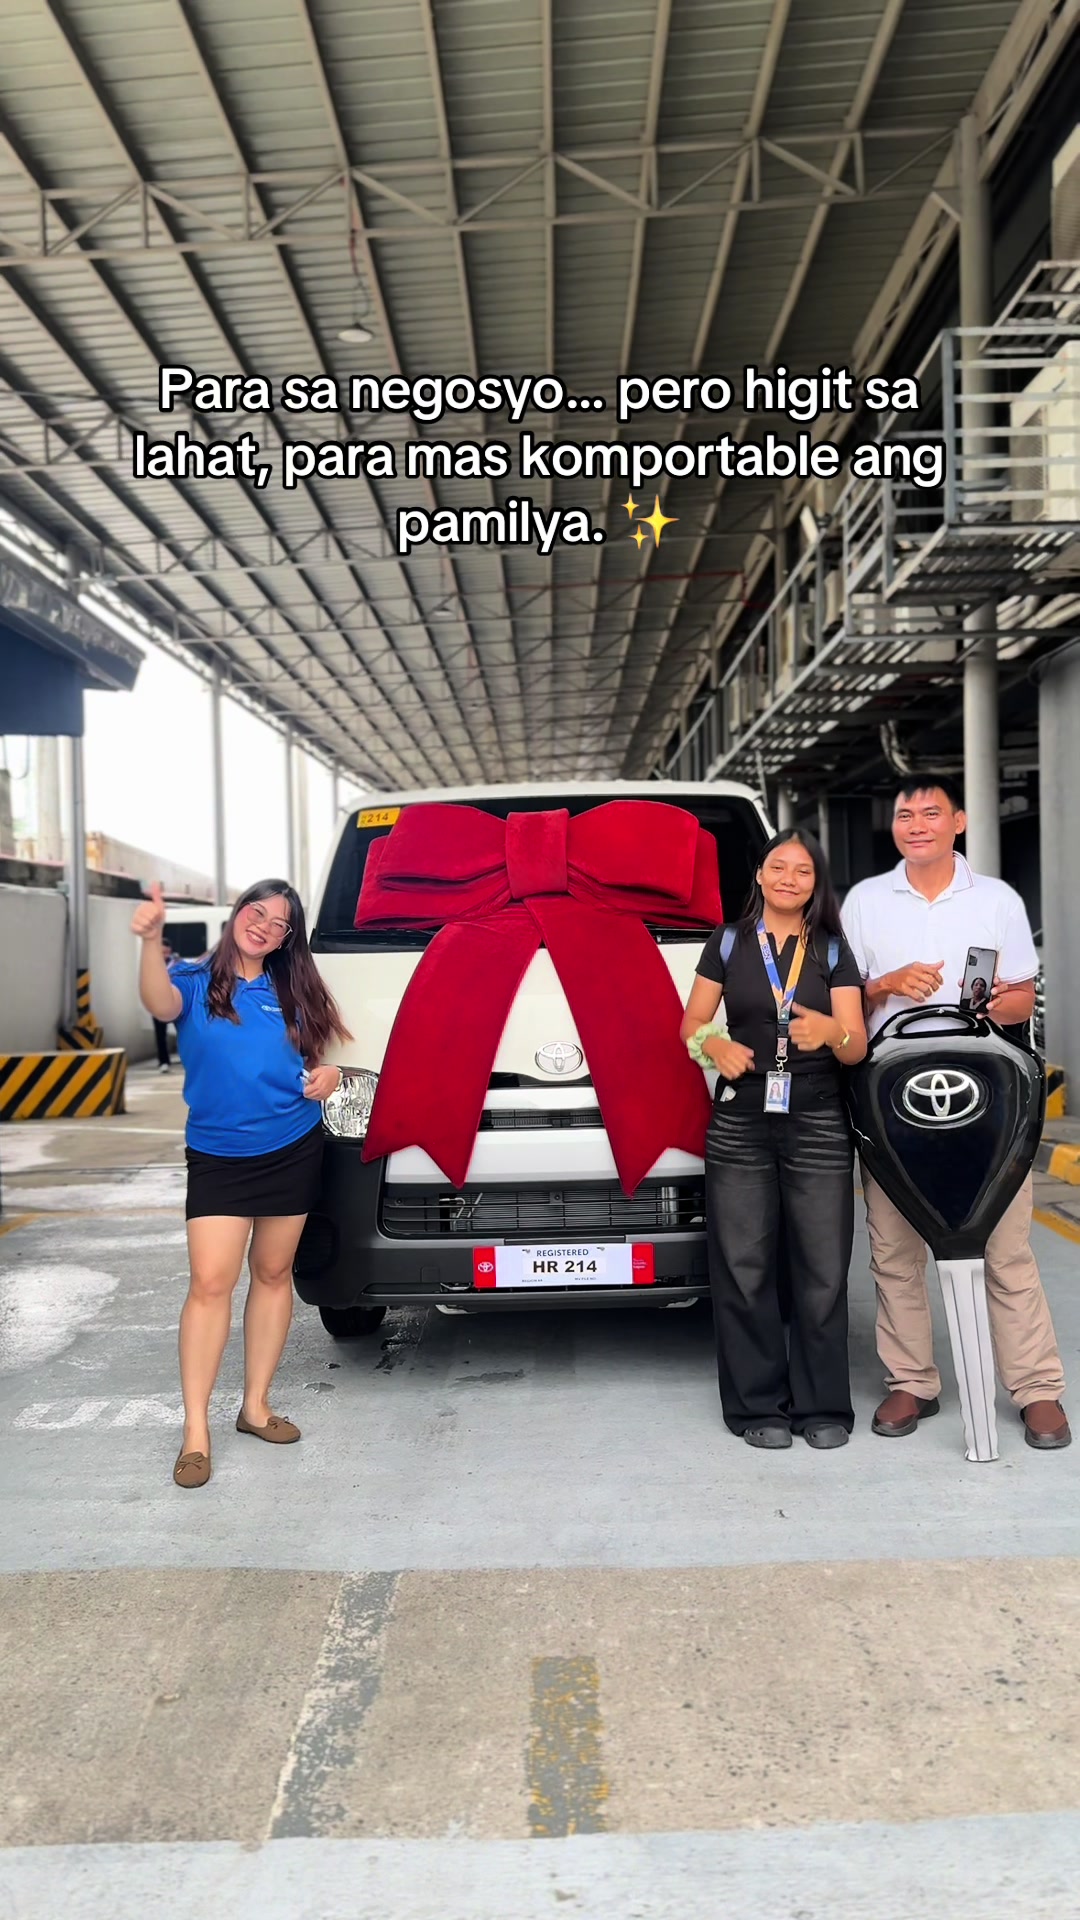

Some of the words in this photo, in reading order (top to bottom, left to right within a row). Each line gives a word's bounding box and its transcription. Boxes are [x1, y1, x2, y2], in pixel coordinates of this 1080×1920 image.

[367, 812, 389, 823] 214
[536, 1248, 589, 1257] REGISTERED
[533, 1260, 559, 1274] HR
[564, 1259, 598, 1274] 214
